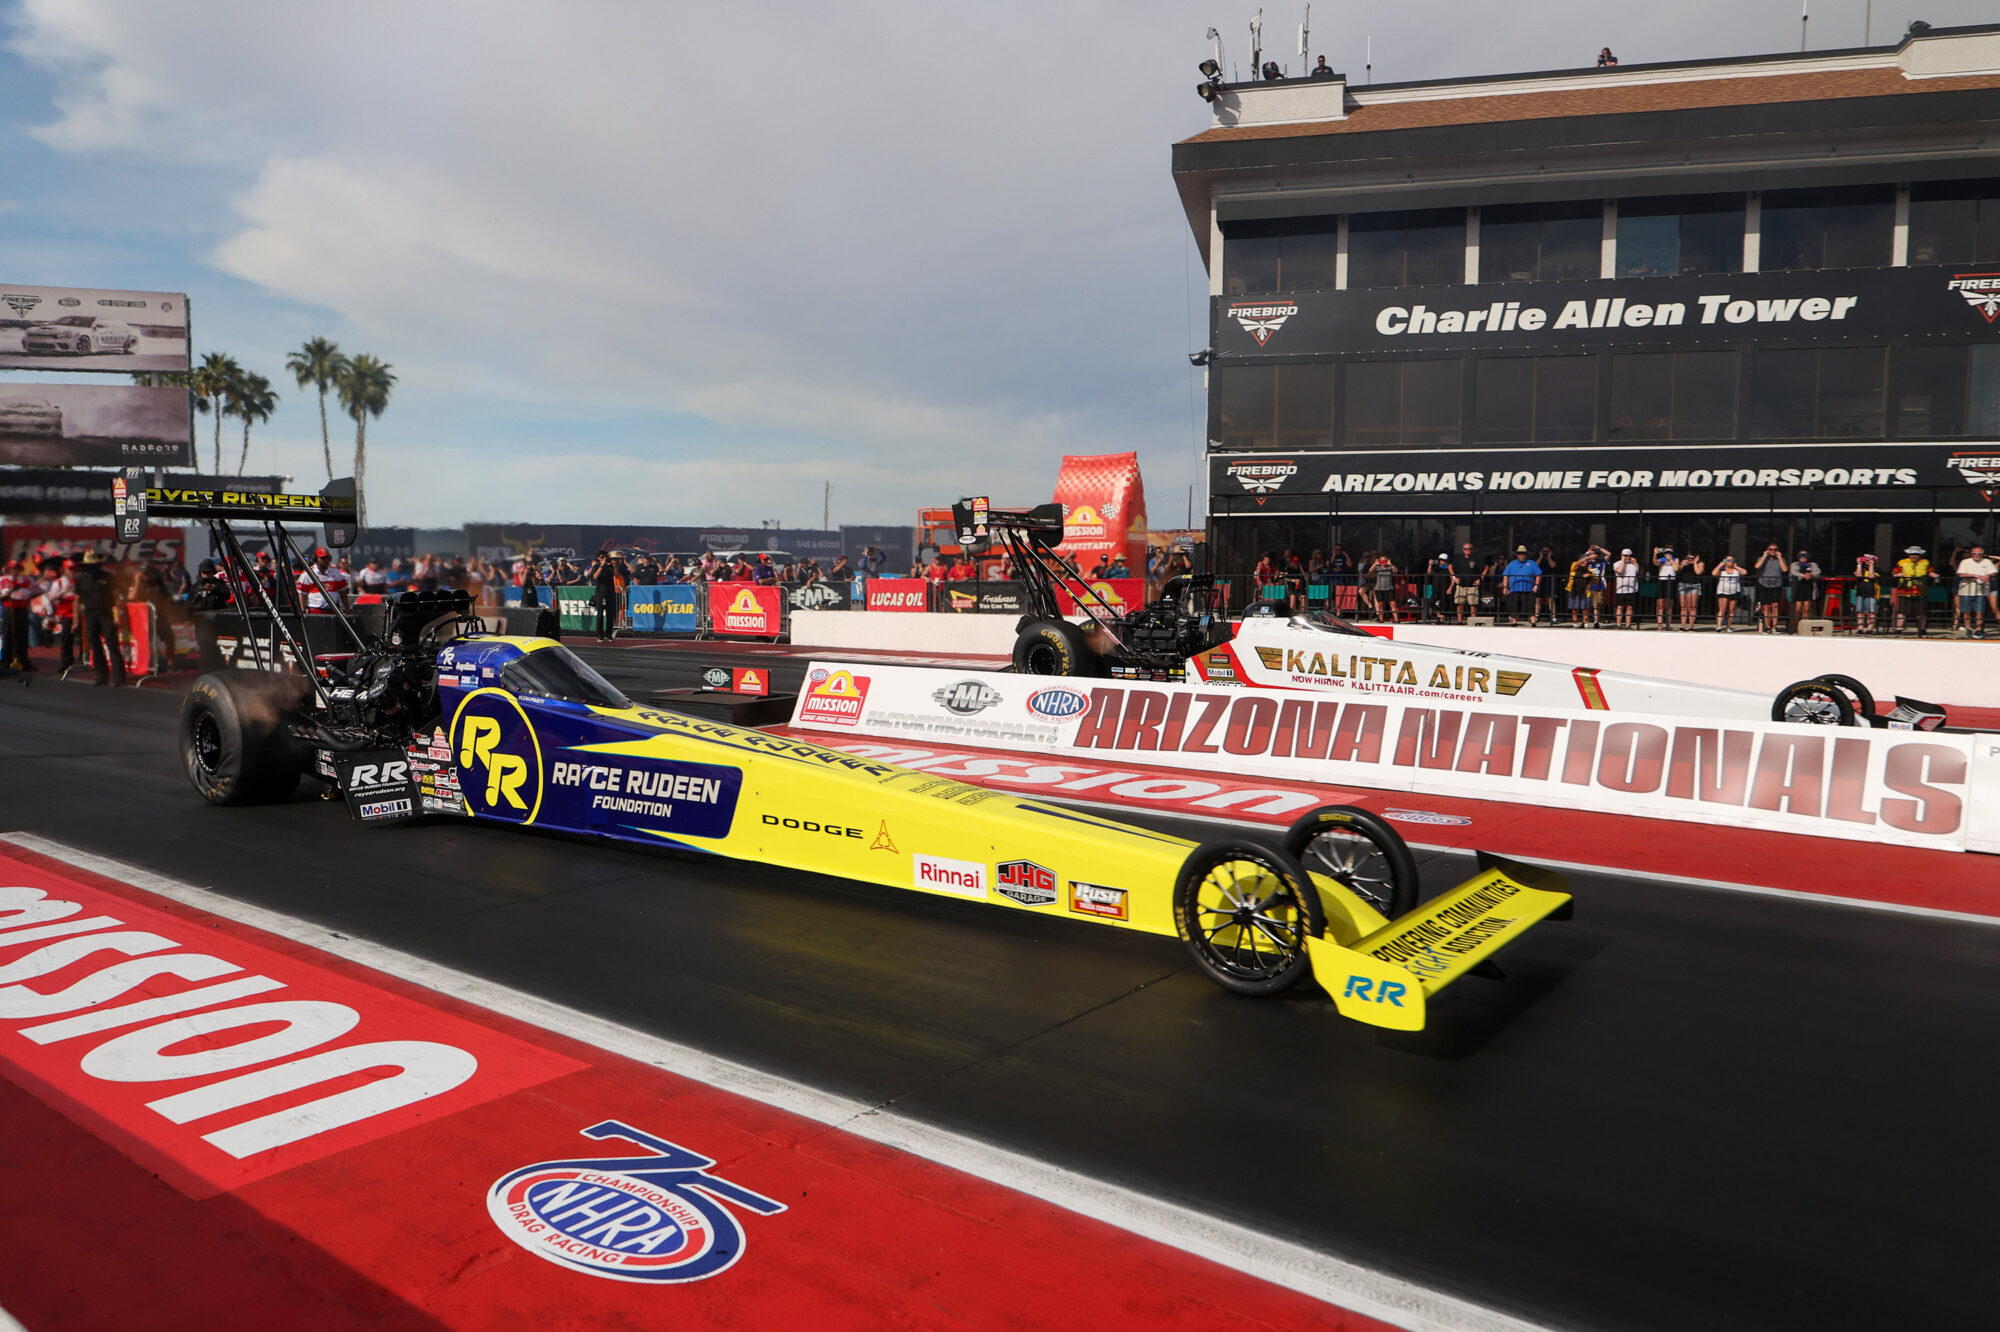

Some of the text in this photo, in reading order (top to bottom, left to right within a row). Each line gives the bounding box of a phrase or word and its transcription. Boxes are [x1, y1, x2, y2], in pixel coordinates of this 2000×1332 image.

[1228, 304, 1299, 318] FIREBIRD
[1375, 294, 1858, 336] Charlie Allen Tower
[1226, 464, 1298, 476] FIREBIRD
[1322, 468, 1918, 493] ARIZONA'S HOME FOR MOTORSPORTS
[700, 534, 750, 543] FIREBIRD
[633, 600, 695, 617] GOODYEAR
[870, 592, 924, 607] LUCAS OIL
[1208, 668, 1226, 676] Mobil
[1287, 648, 1492, 694] KALITTA AIR
[942, 684, 996, 709] FMP
[1039, 685, 1082, 695] CHAMPIONSHIP
[1292, 675, 1483, 703] NOW HIRING KALITTAAIR.com/careers
[1035, 694, 1081, 715] NHRA
[1072, 687, 1388, 764] ARIZONA
[459, 714, 530, 810] RR
[743, 735, 894, 777] RUDEEN
[350, 760, 408, 787] RR
[551, 761, 721, 804] RAYCE RUDEEN
[1392, 706, 1968, 836] NATIONALS
[362, 802, 395, 816] Mobil
[592, 795, 672, 818] FOUNDATION
[761, 814, 865, 839] DODGE
[920, 862, 981, 889] Rinnai
[999, 864, 1054, 890] JHG
[1006, 891, 1047, 903] GARAGE
[1435, 878, 1522, 929] COMMUNITIES
[1369, 919, 1443, 963] POWERING
[1342, 974, 1407, 1008] RR
[581, 1172, 700, 1228] CHAMPIONSHIP
[532, 1181, 679, 1254] NHRA
[508, 1202, 623, 1266] DRAG RACING
